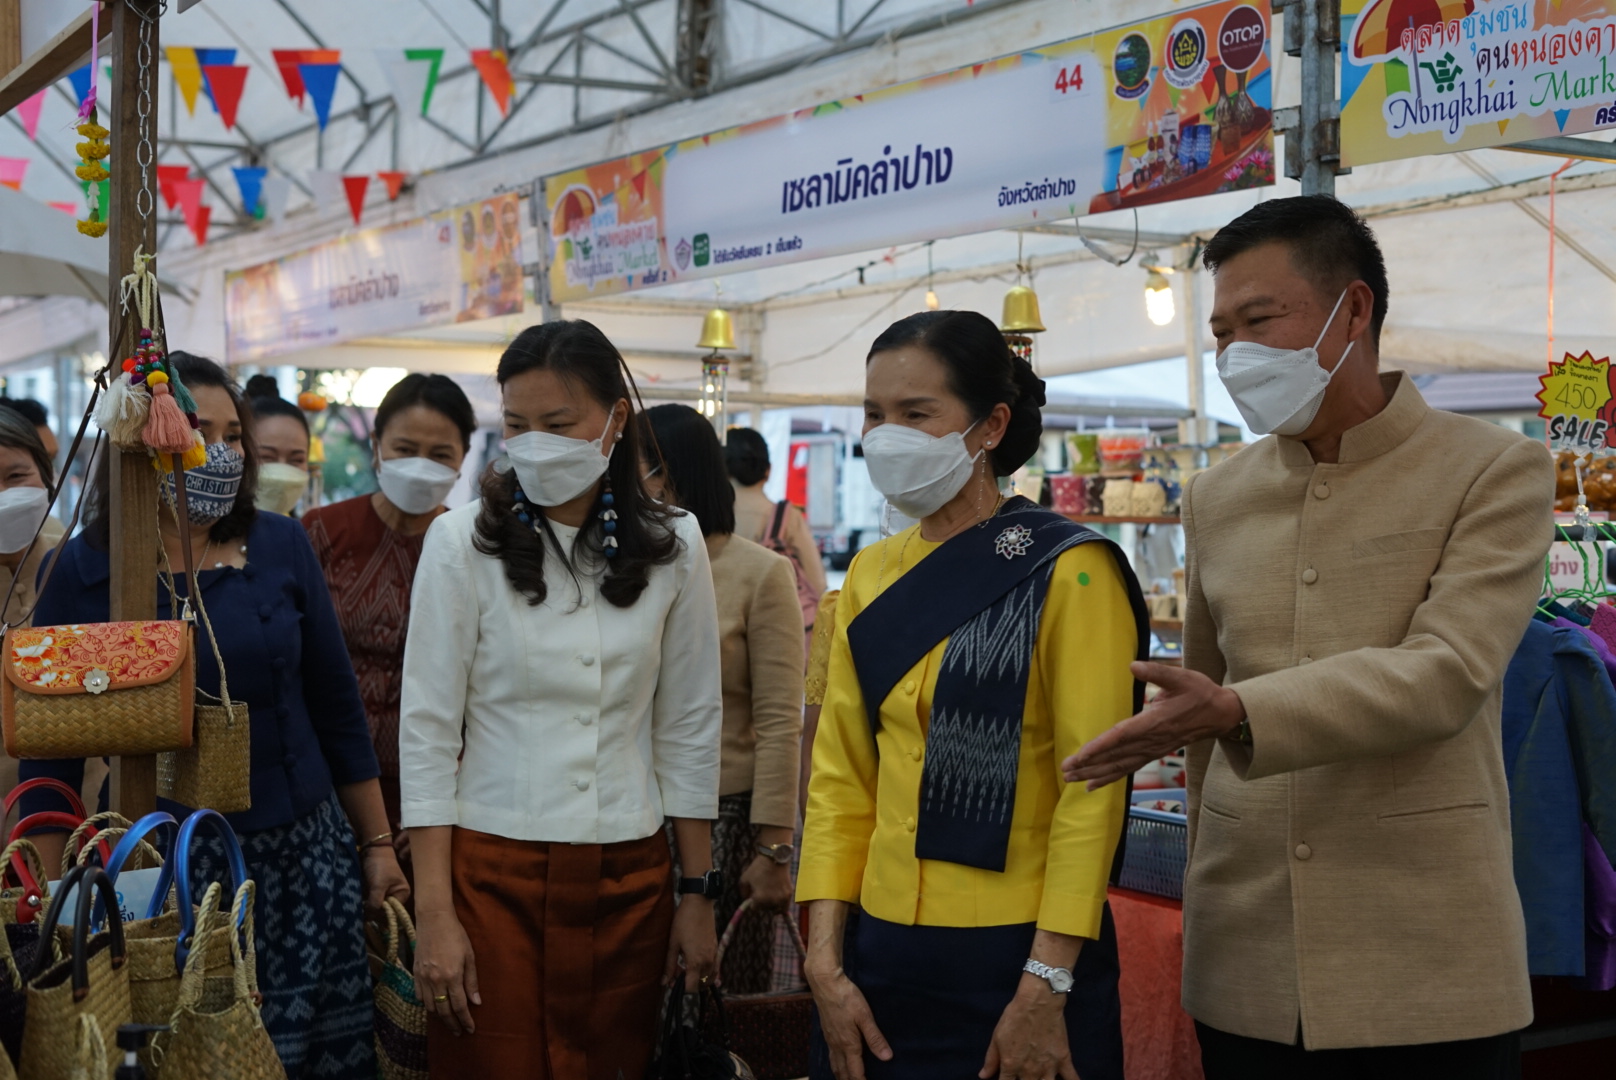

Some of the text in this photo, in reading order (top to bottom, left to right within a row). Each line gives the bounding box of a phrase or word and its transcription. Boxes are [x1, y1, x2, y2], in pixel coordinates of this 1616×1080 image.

[1222, 24, 1261, 46] OTOP
[1401, 1, 1527, 58] ตลาดชุมชน
[1054, 64, 1083, 94] 44
[1388, 78, 1518, 135] Nongkhai
[781, 144, 953, 214] เซลามิคลำปาง
[998, 177, 1076, 207] จังหวัดลำปาง
[1555, 382, 1597, 410] 450
[1550, 415, 1606, 448] SALE
[185, 475, 232, 495] CHRISTIAN
